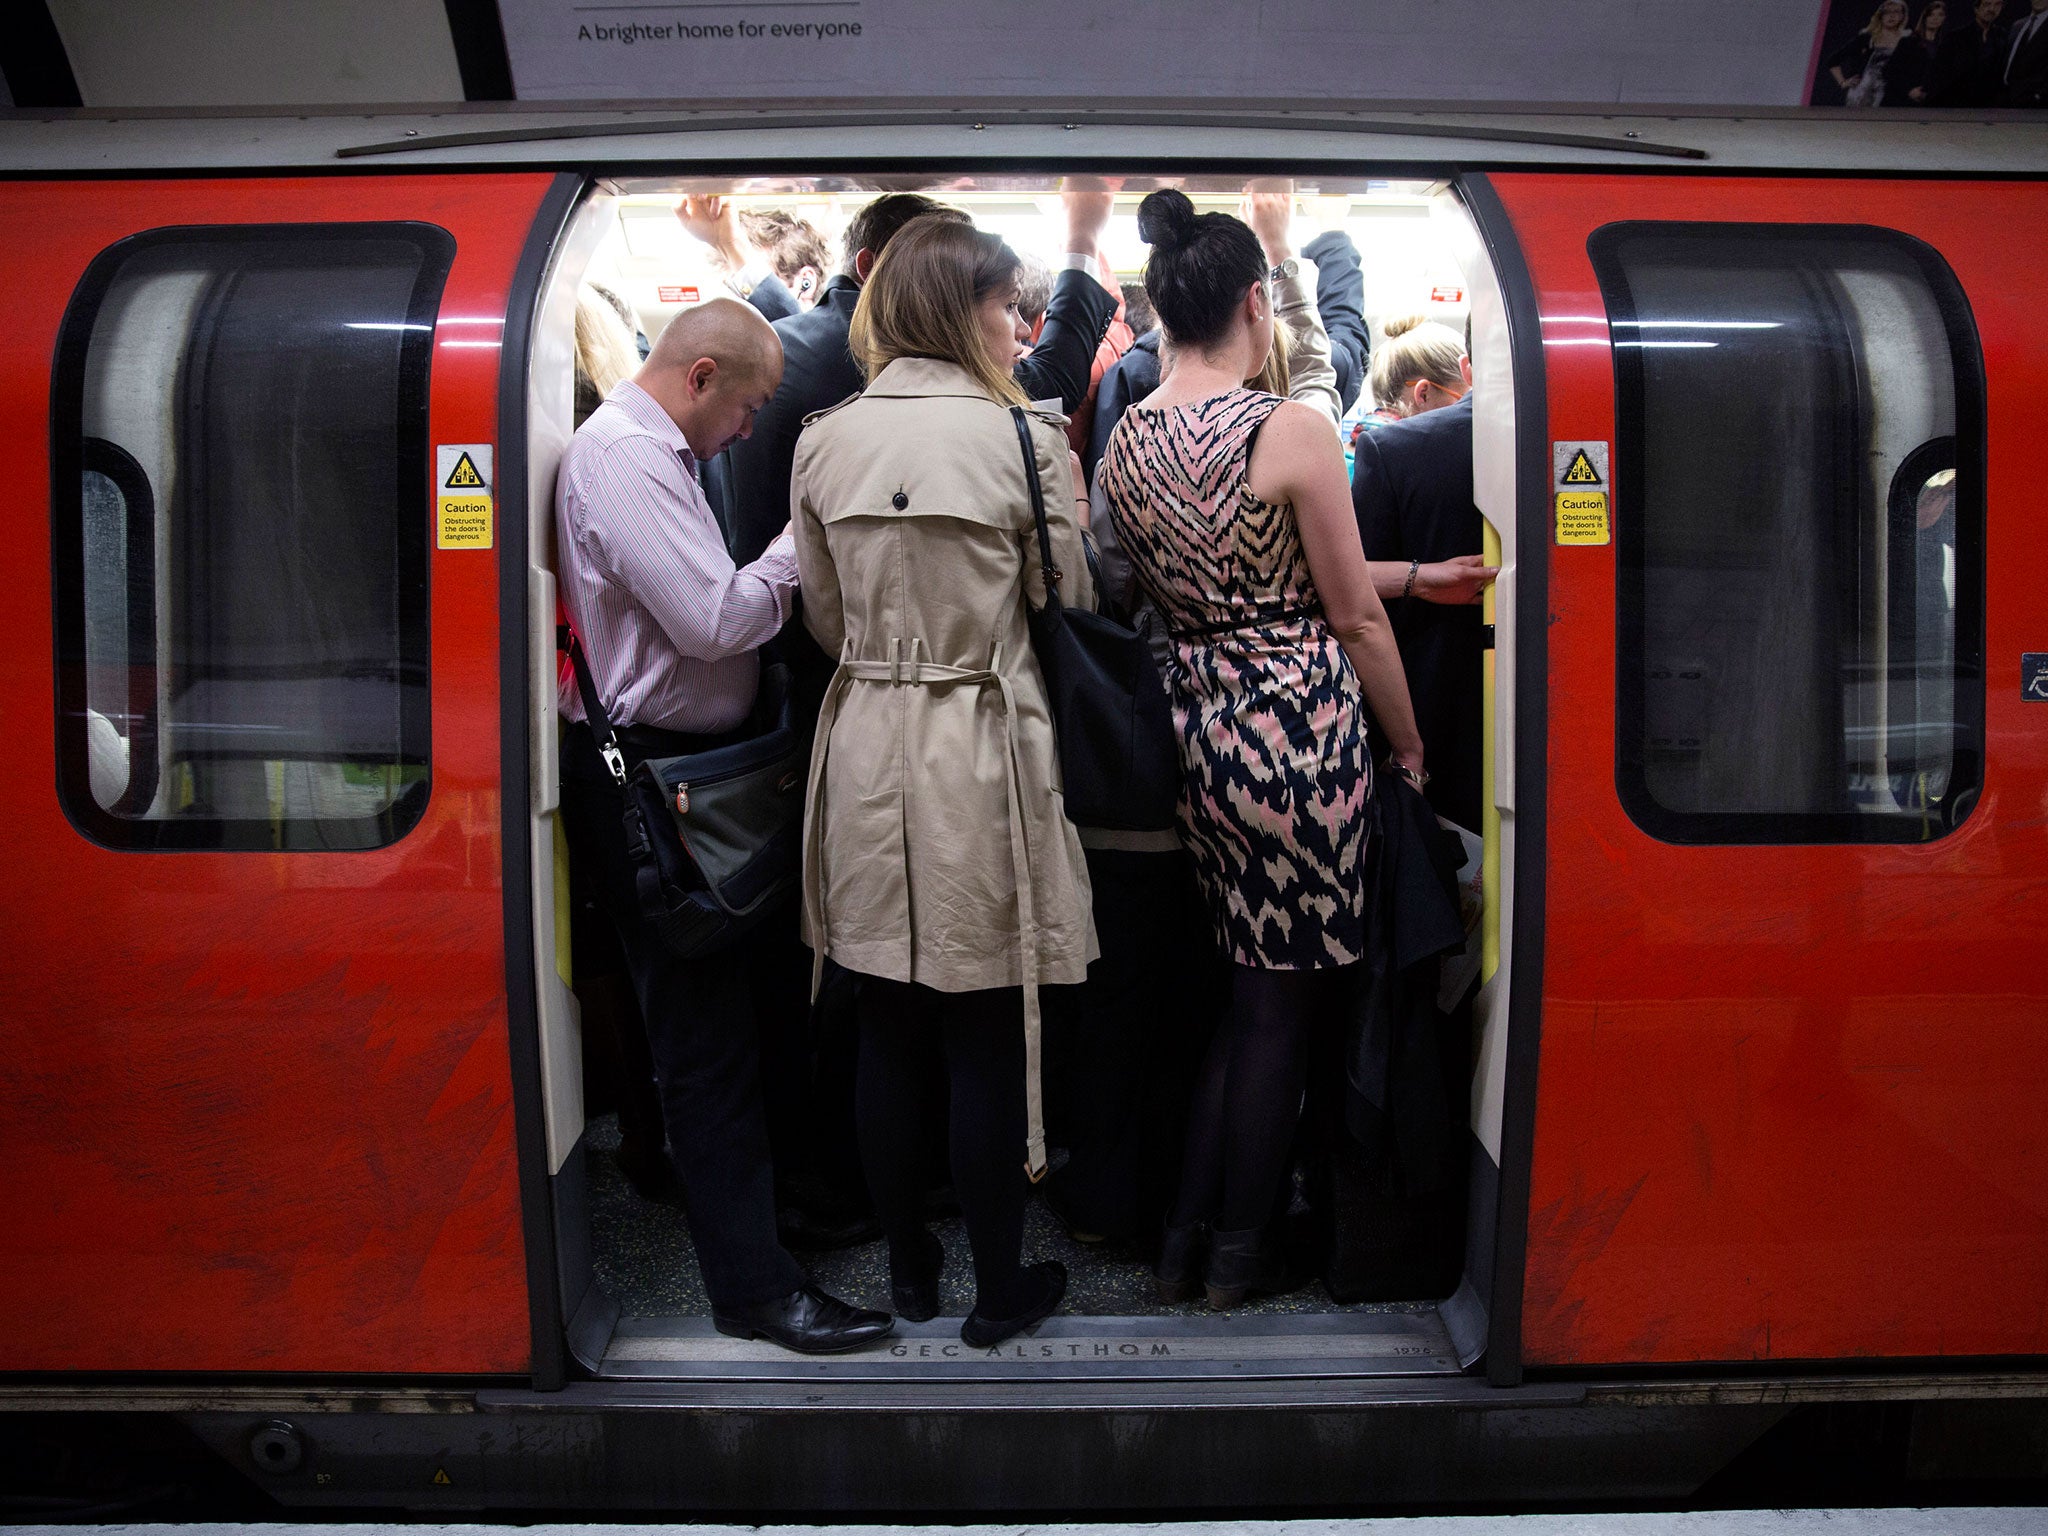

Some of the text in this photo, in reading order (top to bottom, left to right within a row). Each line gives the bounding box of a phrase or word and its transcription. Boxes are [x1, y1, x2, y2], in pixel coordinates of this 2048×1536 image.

[578, 20, 863, 44] A brighter home for everyone
[445, 503, 486, 513] Caution
[1562, 499, 1603, 509] Caution
[445, 533, 480, 541] dangerous
[890, 1343, 1171, 1358] GEC ALSTHOM
